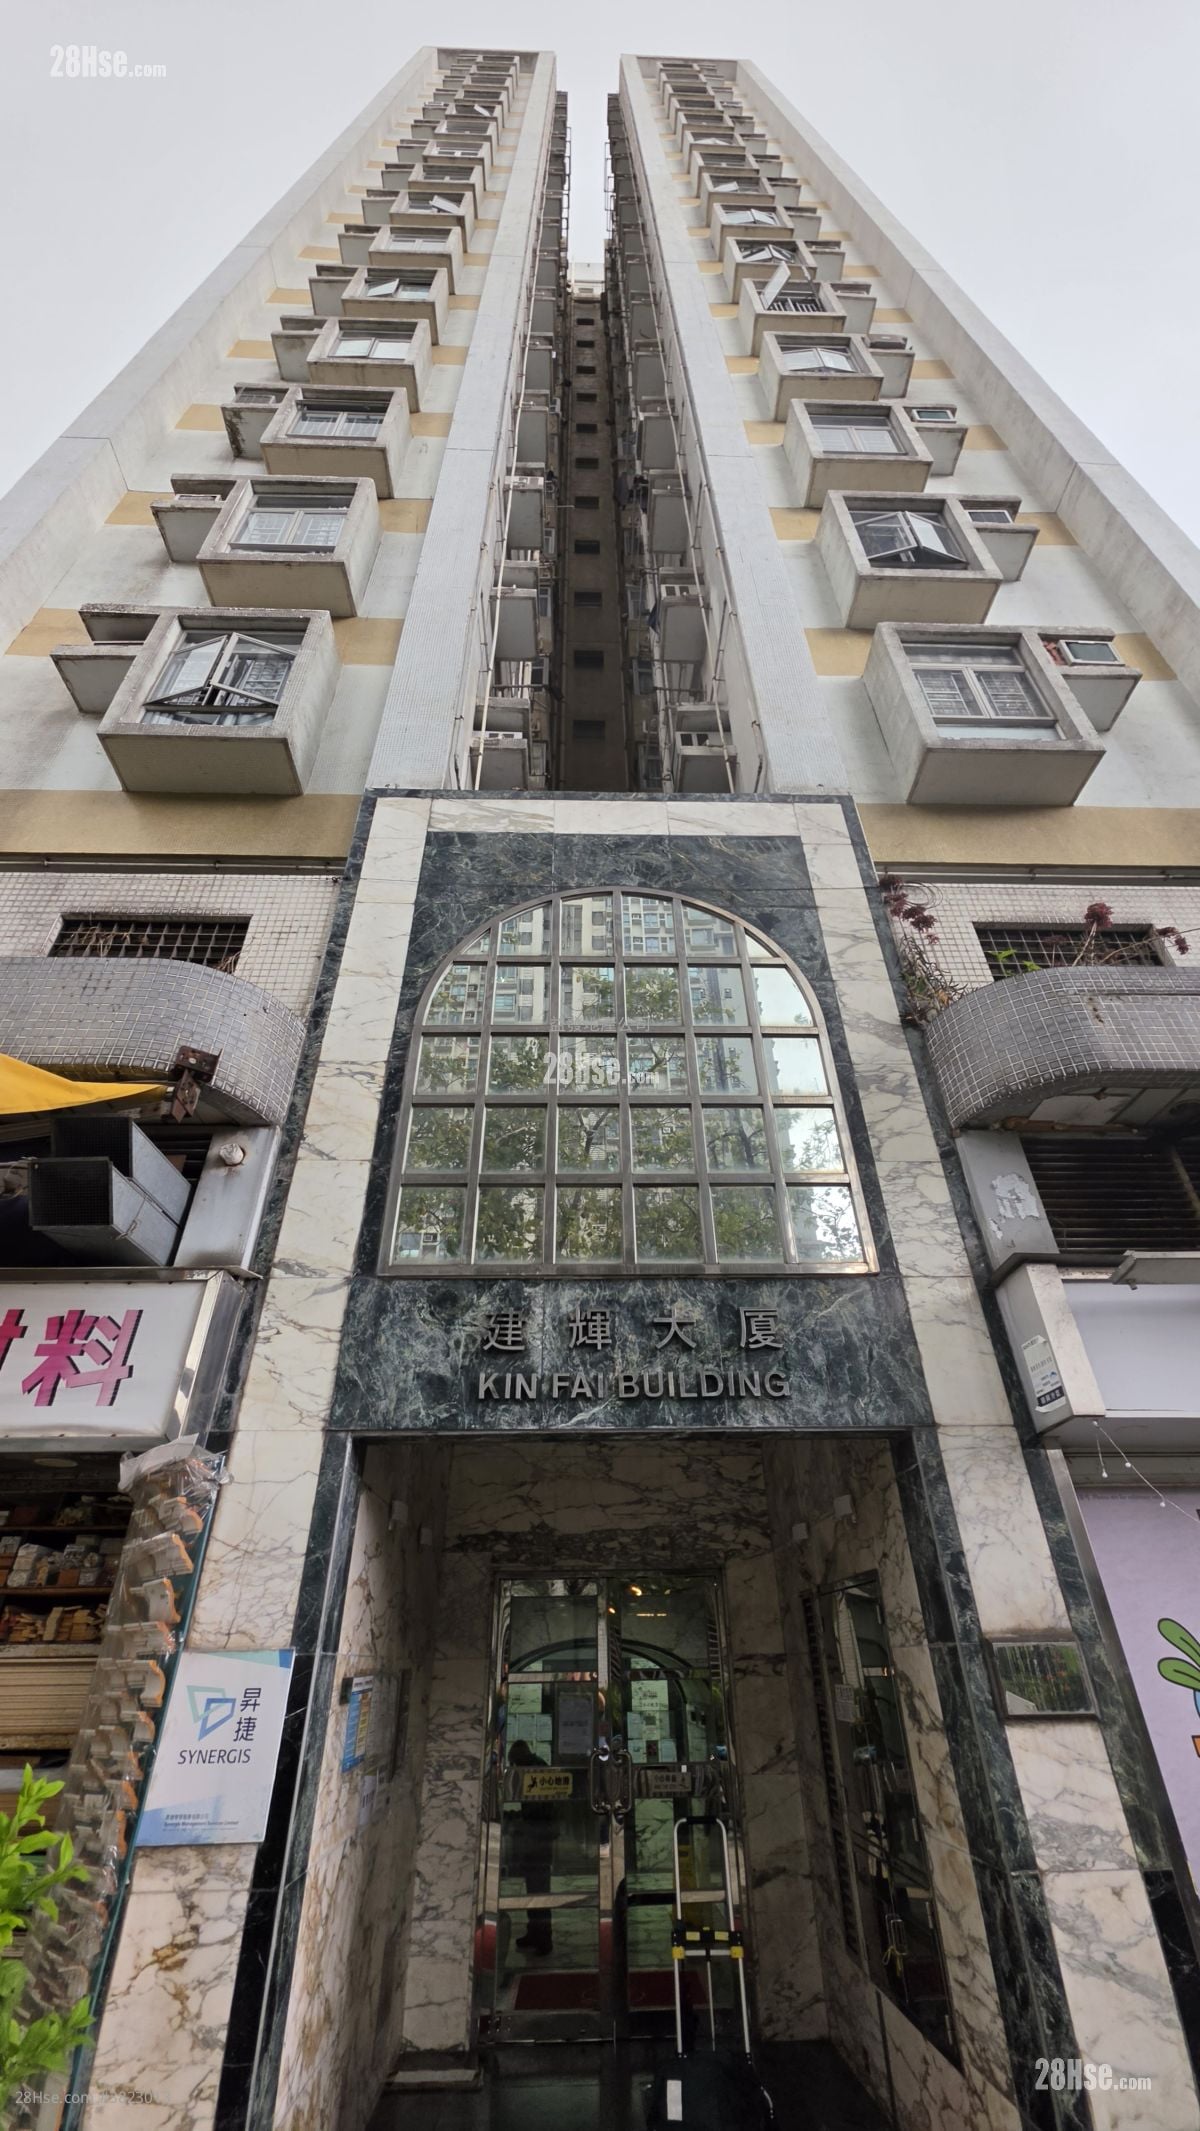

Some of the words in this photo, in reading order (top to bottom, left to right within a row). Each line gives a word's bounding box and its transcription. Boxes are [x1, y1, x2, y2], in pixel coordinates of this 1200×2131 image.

[478, 1372, 538, 1399] KIN
[552, 1371, 604, 1399] FAI
[618, 1369, 790, 1398] BUILDING
[233, 1687, 262, 1742] 昇捷
[177, 1748, 252, 1765] SYNERGIS
